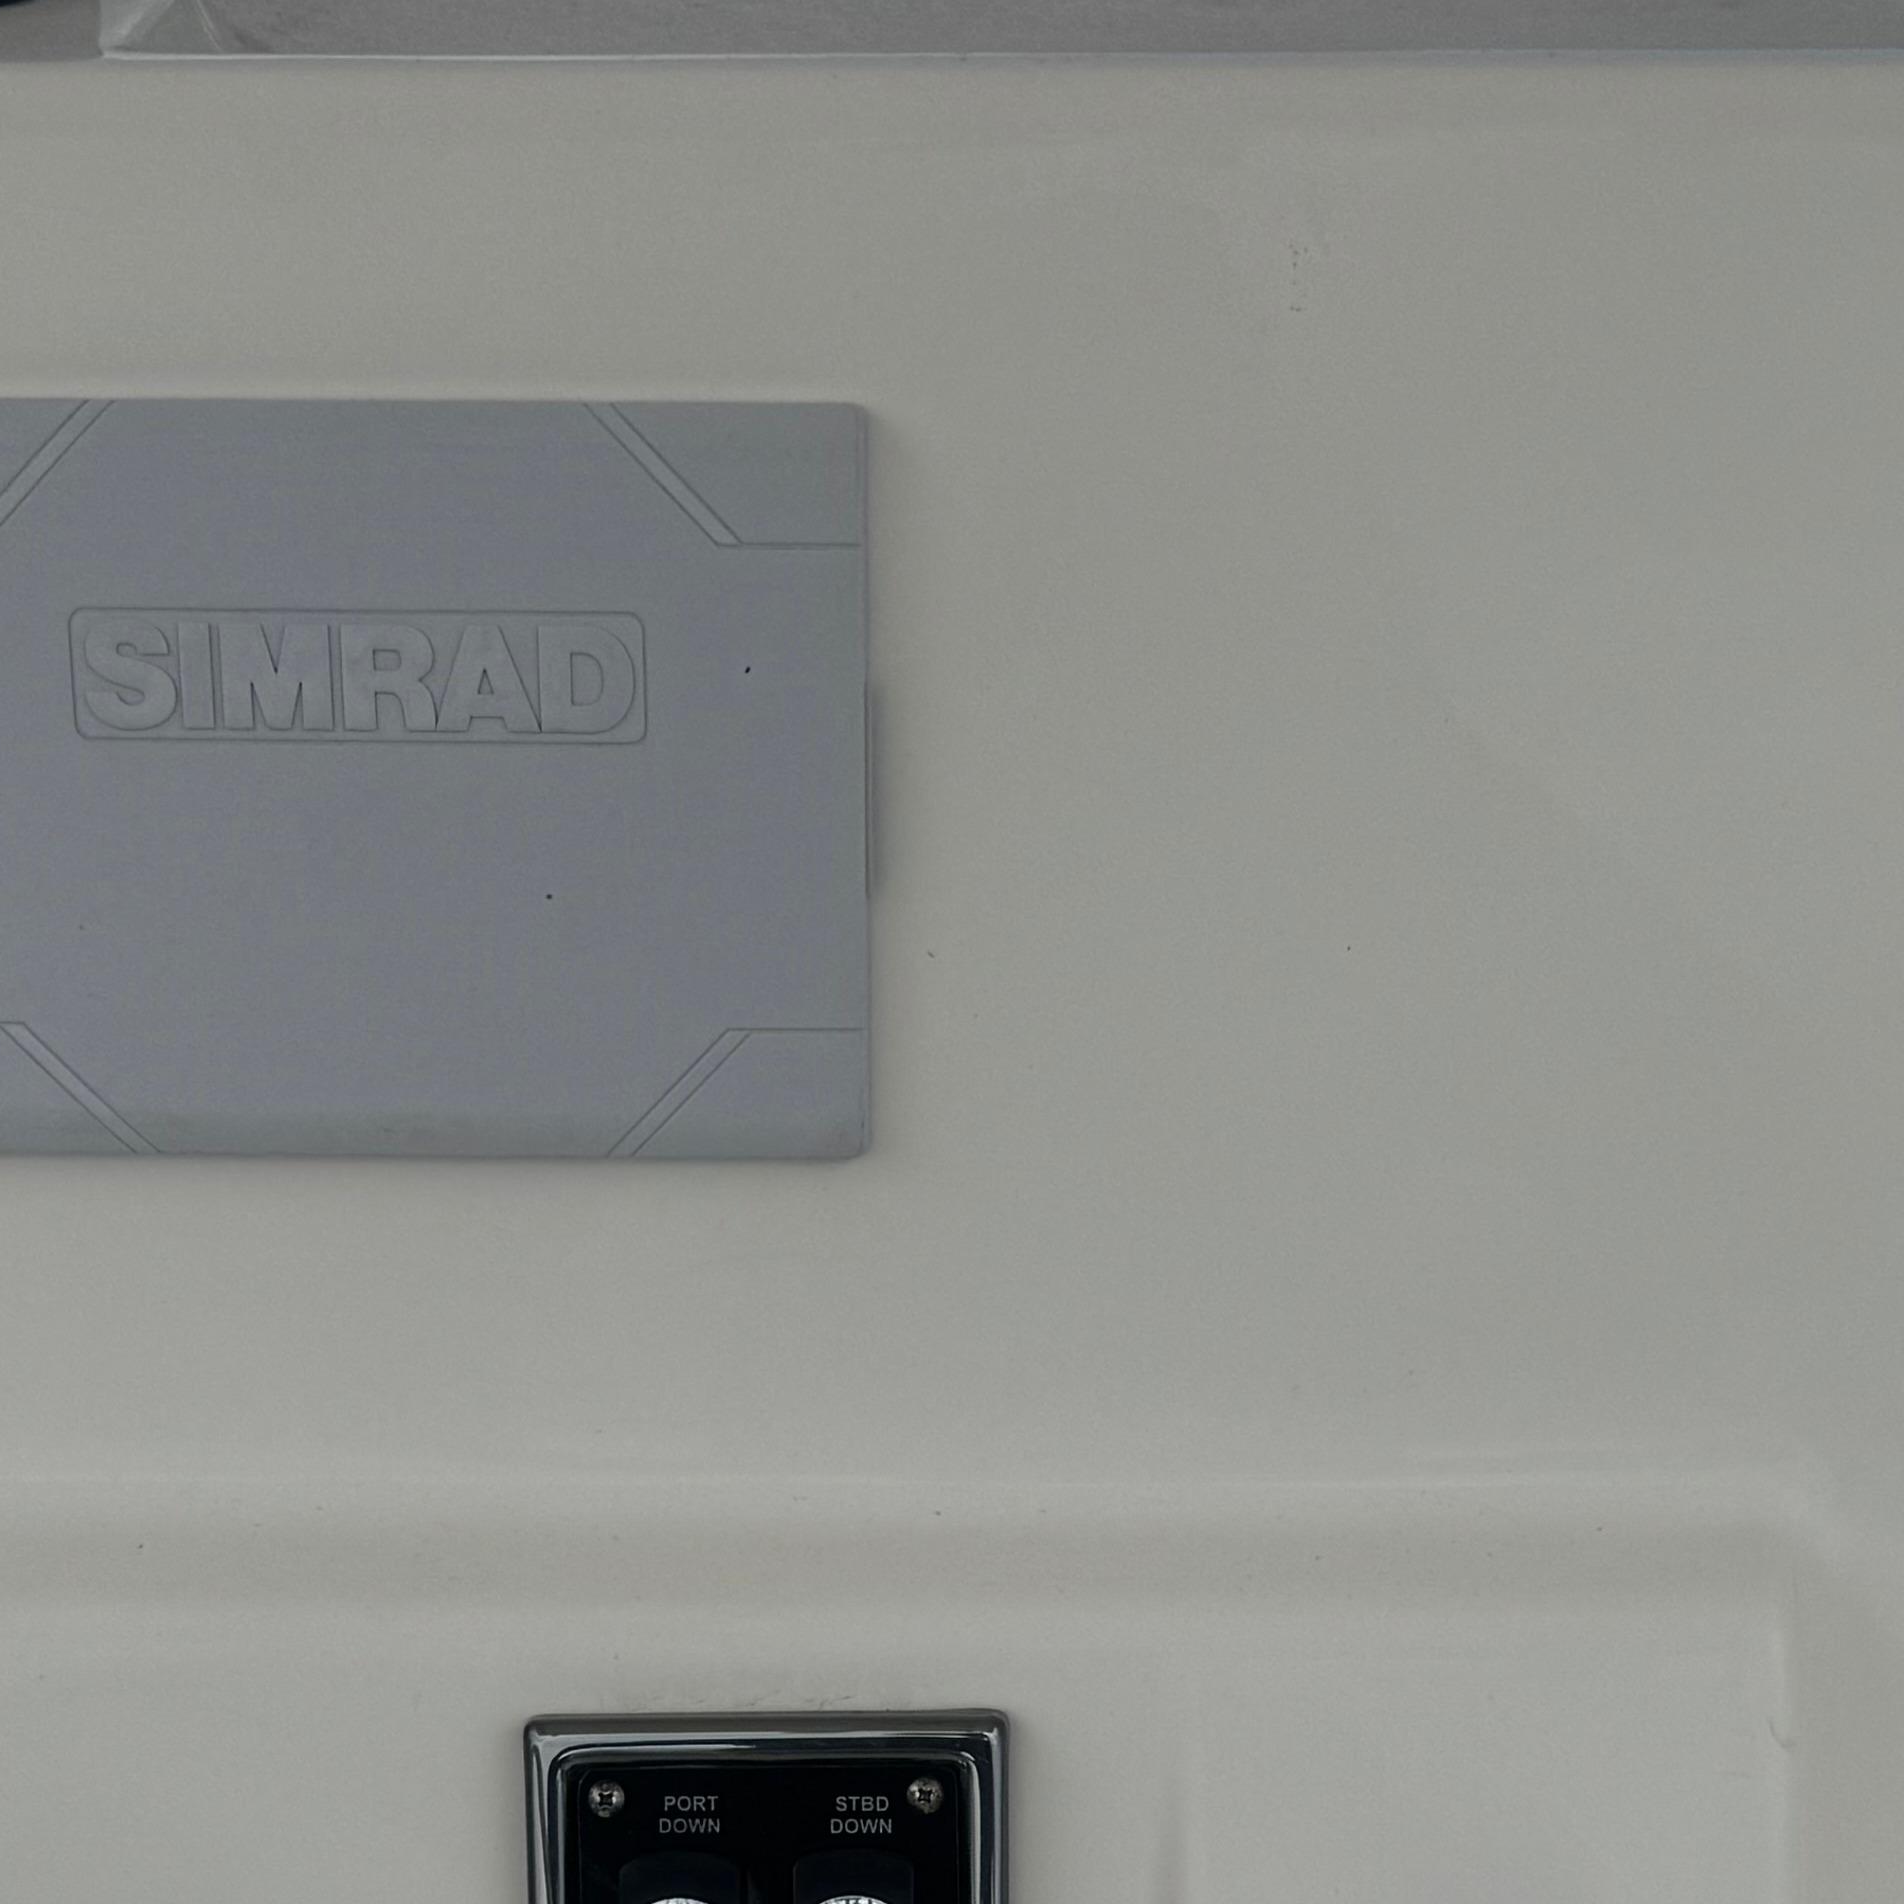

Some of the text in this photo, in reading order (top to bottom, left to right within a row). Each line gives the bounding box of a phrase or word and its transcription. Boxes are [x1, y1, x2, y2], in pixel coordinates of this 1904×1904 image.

[82, 619, 636, 734] SIMRAD
[665, 1796, 719, 1812] PORT
[836, 1796, 890, 1812] STBD
[659, 1818, 721, 1834] DOWN
[831, 1819, 893, 1835] DOWN
